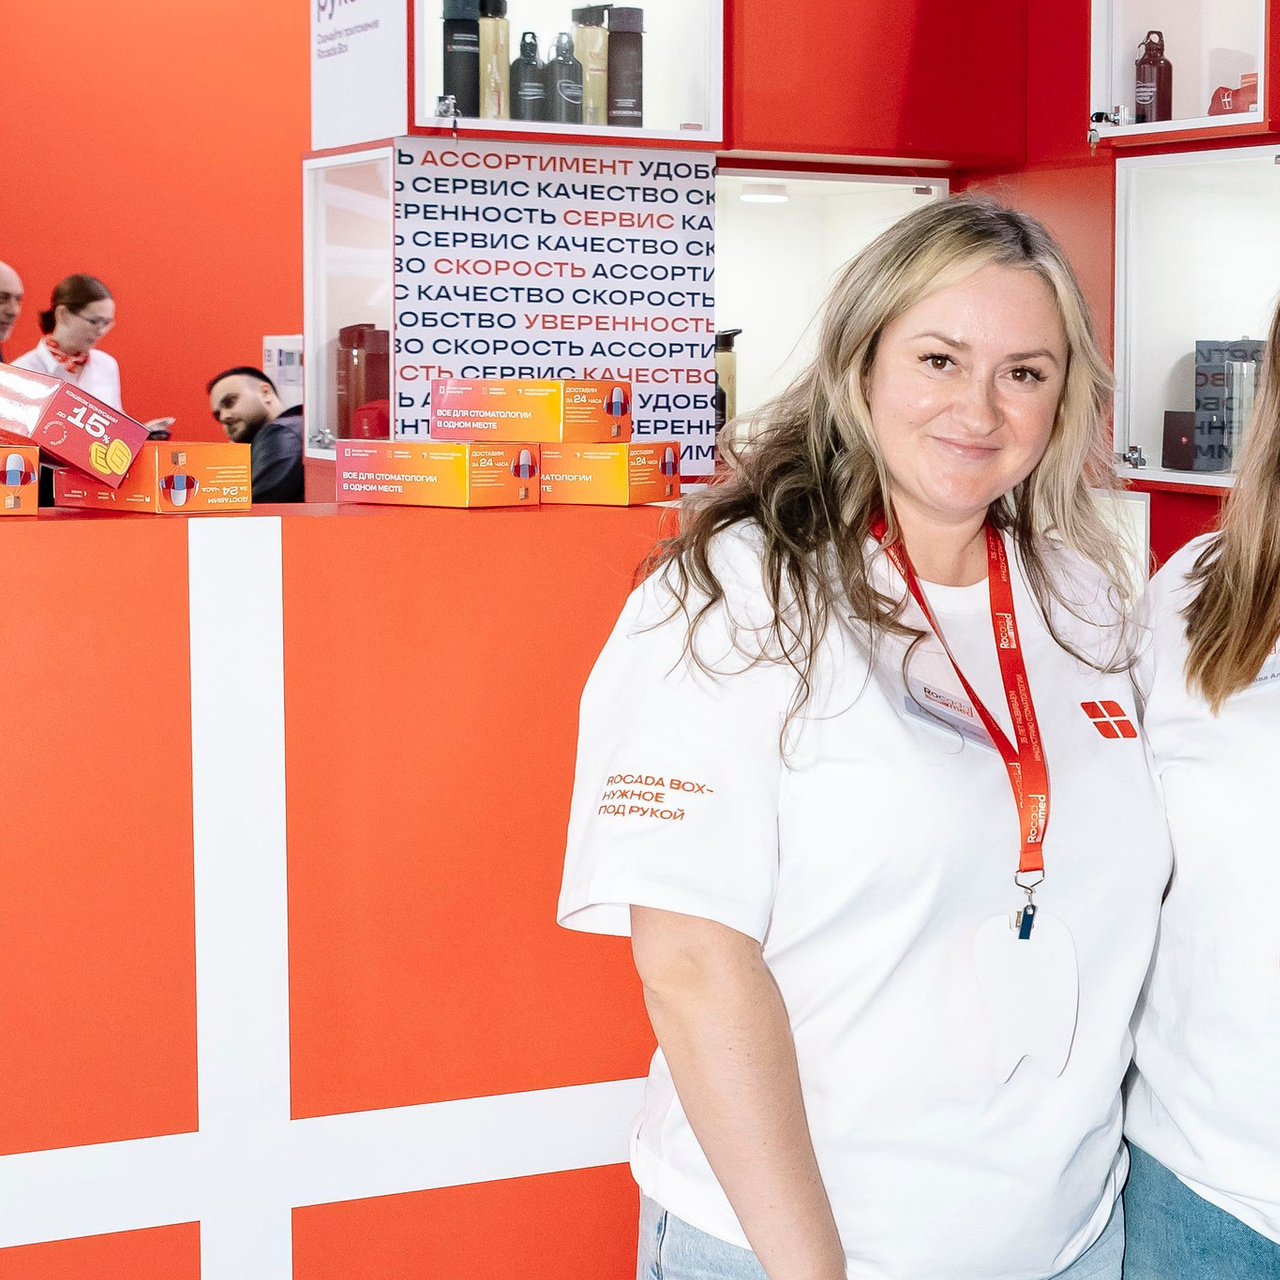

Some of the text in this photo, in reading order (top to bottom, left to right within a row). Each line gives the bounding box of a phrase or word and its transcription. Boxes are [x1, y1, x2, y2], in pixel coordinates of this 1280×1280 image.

[420, 149, 633, 177] АССОРТИМЕНТ
[412, 176, 530, 198] СЕРВИС
[537, 182, 678, 204] КАЧЕСТВО
[563, 209, 675, 230] СЕРВИС
[682, 215, 716, 231] КА
[412, 231, 530, 250] СЕРВИС
[537, 234, 678, 256] КАЧЕСТВО
[433, 258, 586, 279] СКОРОСТЬ
[417, 284, 564, 305] КАЧЕСТВО
[572, 287, 715, 308] СКОРОСТЬ
[395, 311, 517, 330] ОБСТВО
[432, 338, 584, 358] СКОРОСТЬ
[395, 365, 717, 385] СТЬ СЕРВИС КАЧЕСТВО
[566, 386, 598, 394] ДОСТАВИМ
[573, 394, 587, 404] 24
[436, 408, 532, 420] ВСЕ ДЛЯ СТОМАТОЛОГИИ
[395, 419, 716, 435] НТ ЕРЕНН
[436, 420, 498, 430] В ОДНОМ МЕСТЕ
[471, 450, 504, 458] ДОСТАВИМ
[636, 457, 646, 466] 24
[479, 458, 493, 468] 24
[343, 471, 437, 483] ВСЕ ДЛЯ СТОМАТОЛОГИИ
[221, 485, 238, 496] 24
[343, 483, 404, 493] В ОДНОМ МЕСТЕ
[207, 496, 248, 504] ДОСТАВИМ
[606, 774, 665, 787] ROCADA
[602, 789, 665, 803] НУЖНОЕ
[598, 804, 685, 821] ПОД РУКОЙ
[1038, 795, 1046, 824] med
[1027, 796, 1039, 843] Rocada
